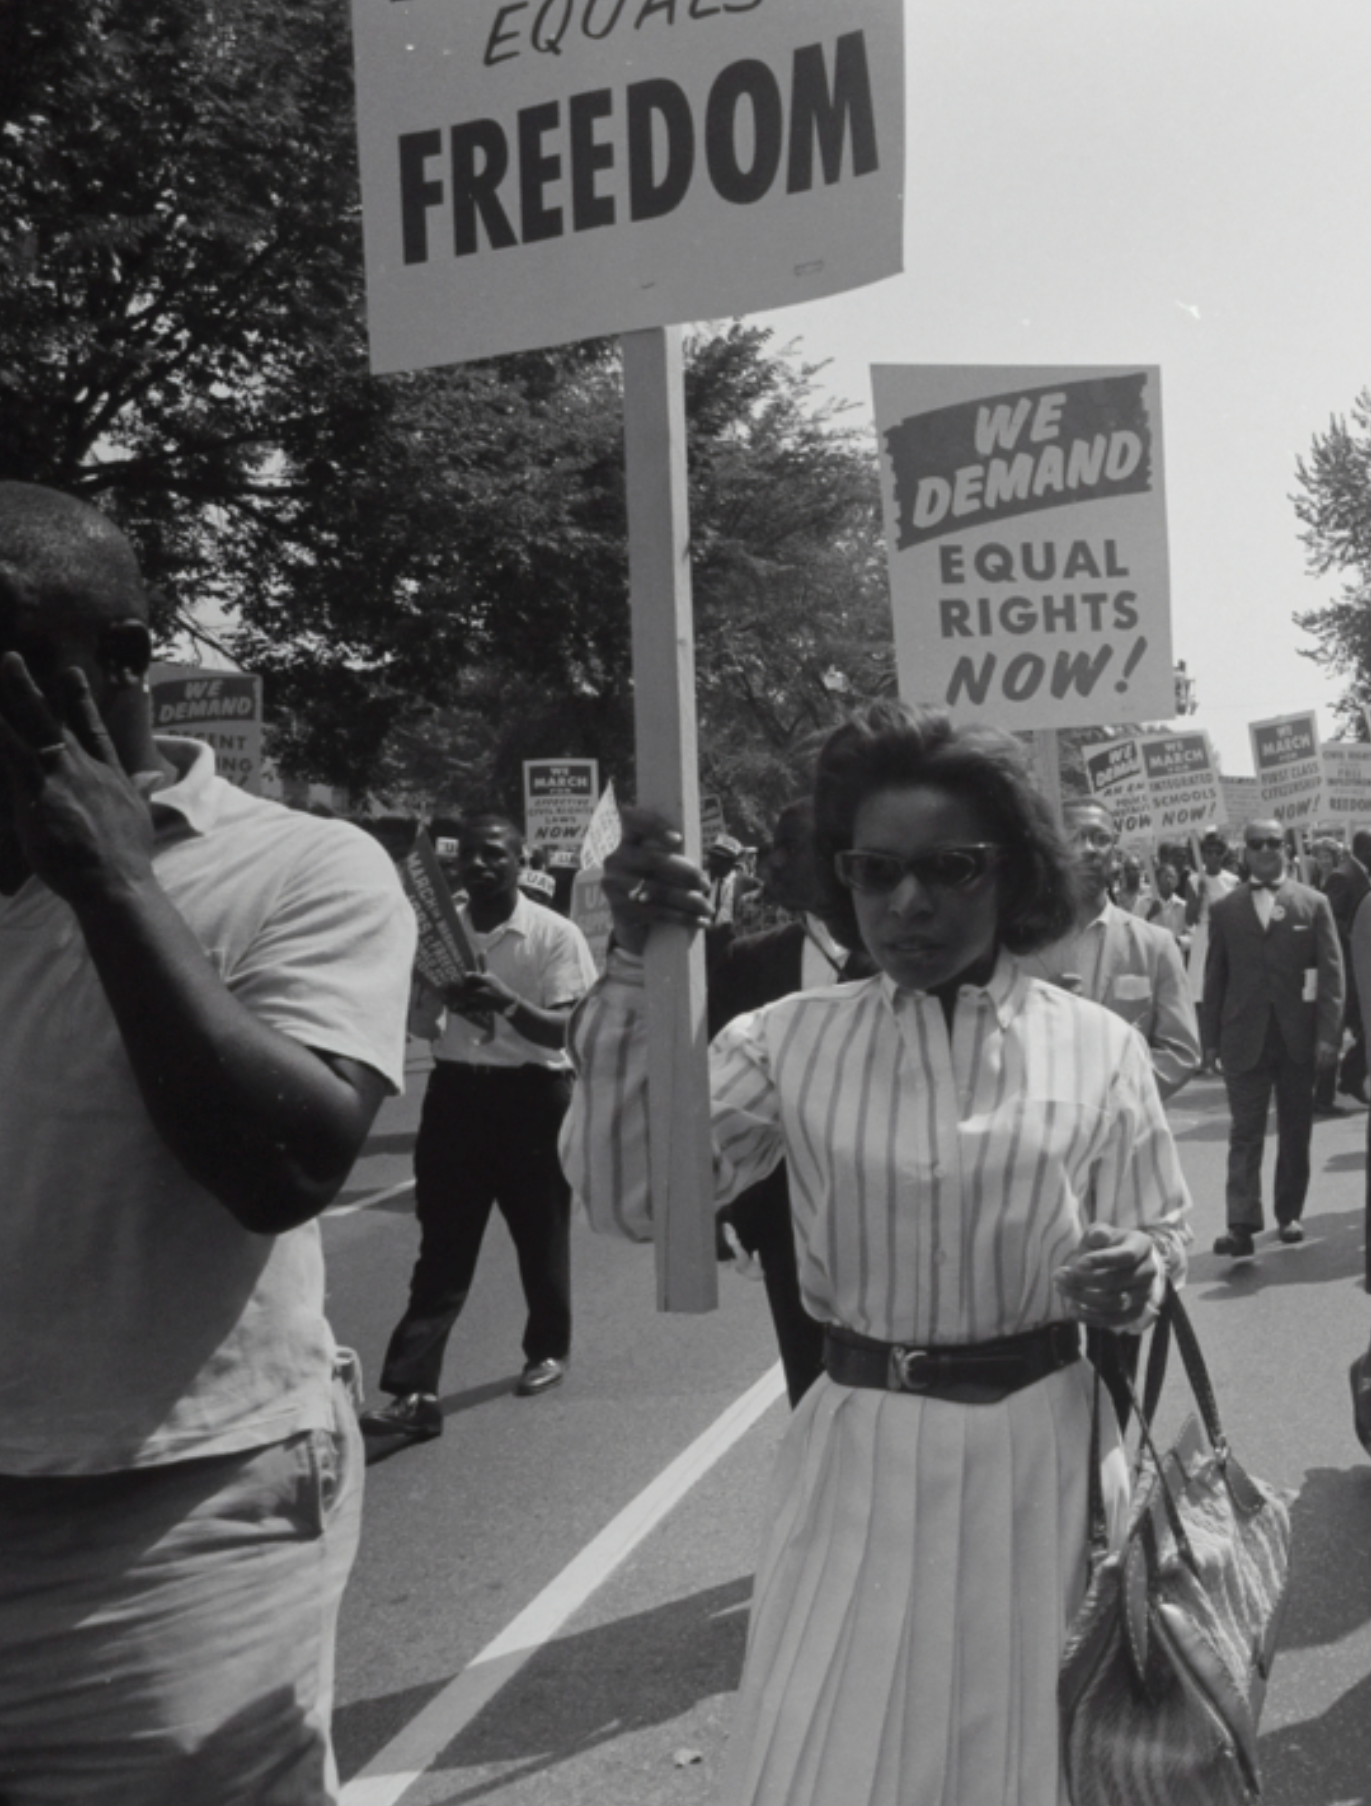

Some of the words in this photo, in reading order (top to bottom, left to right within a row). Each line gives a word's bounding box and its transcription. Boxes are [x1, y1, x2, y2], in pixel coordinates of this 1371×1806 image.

[484, 0, 766, 66] EQU
[399, 28, 879, 266] FREEDOM
[975, 392, 1066, 456] WE
[913, 430, 1143, 529] DEMAND
[939, 539, 1131, 585] EQUAL
[939, 590, 1140, 638] RIGHTS
[945, 635, 1148, 707] NOW!
[185, 679, 224, 700] WE
[159, 697, 251, 723] DEMAND
[1262, 733, 1311, 757] MARCH
[550, 767, 569, 777] WE
[1149, 749, 1204, 770] MARCH
[534, 776, 588, 788] MARCH
[1126, 782, 1145, 793] EN
[1152, 787, 1218, 809] SCHOOLS
[1273, 793, 1321, 820] NOW!
[1113, 813, 1151, 833] NOW
[1161, 801, 1217, 828] NOW!
[526, 874, 553, 893] UA
